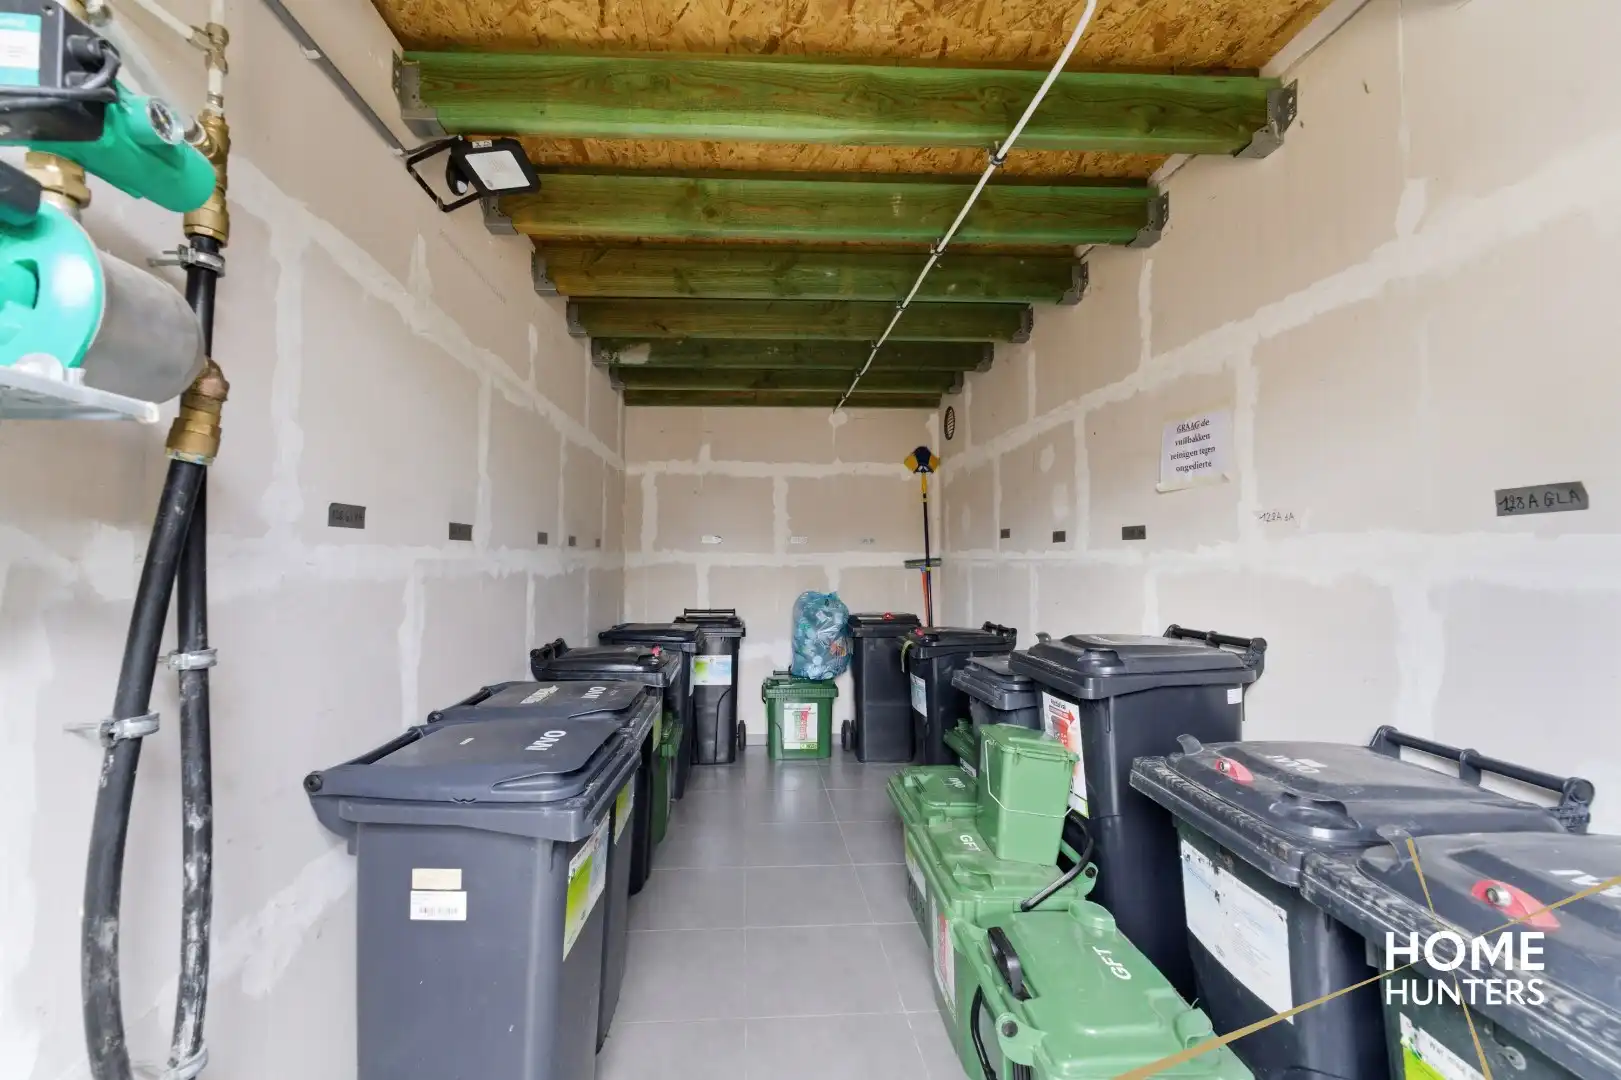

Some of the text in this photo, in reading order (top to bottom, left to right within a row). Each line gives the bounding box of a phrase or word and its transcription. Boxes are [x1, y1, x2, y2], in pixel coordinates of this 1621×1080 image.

[1176, 419, 1210, 434] GRAAG de
[1174, 433, 1210, 446] vuilbakken
[1170, 446, 1216, 461] reinigen tegen
[1175, 461, 1212, 473] ongedierte
[959, 834, 982, 852] GFT
[1091, 945, 1132, 980] GFT
